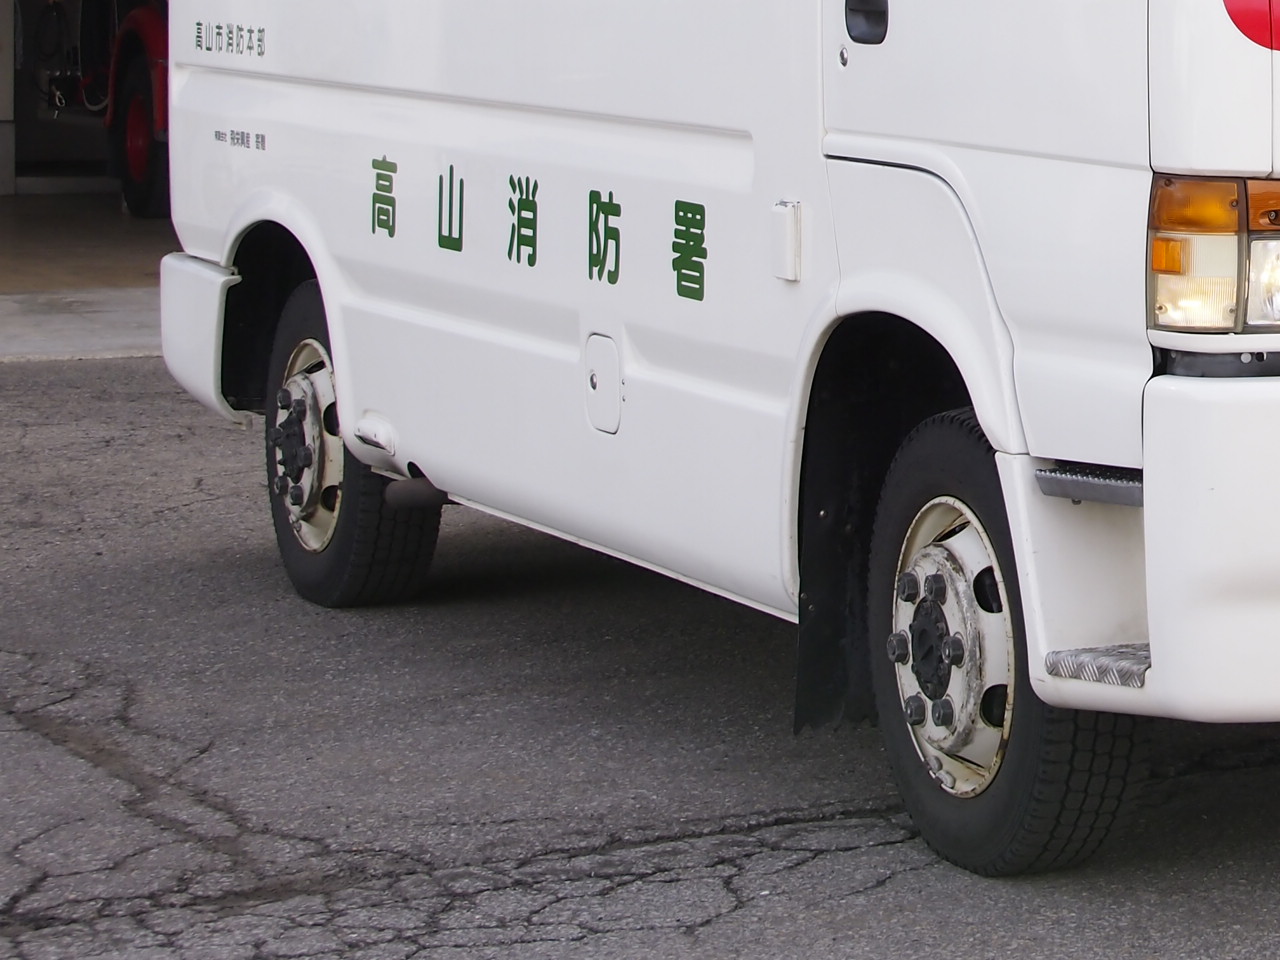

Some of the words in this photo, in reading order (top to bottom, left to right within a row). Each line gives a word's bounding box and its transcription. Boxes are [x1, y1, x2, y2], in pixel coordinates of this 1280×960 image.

[195, 20, 266, 57] 高山市消防本部
[371, 155, 708, 302] 高山消防署
